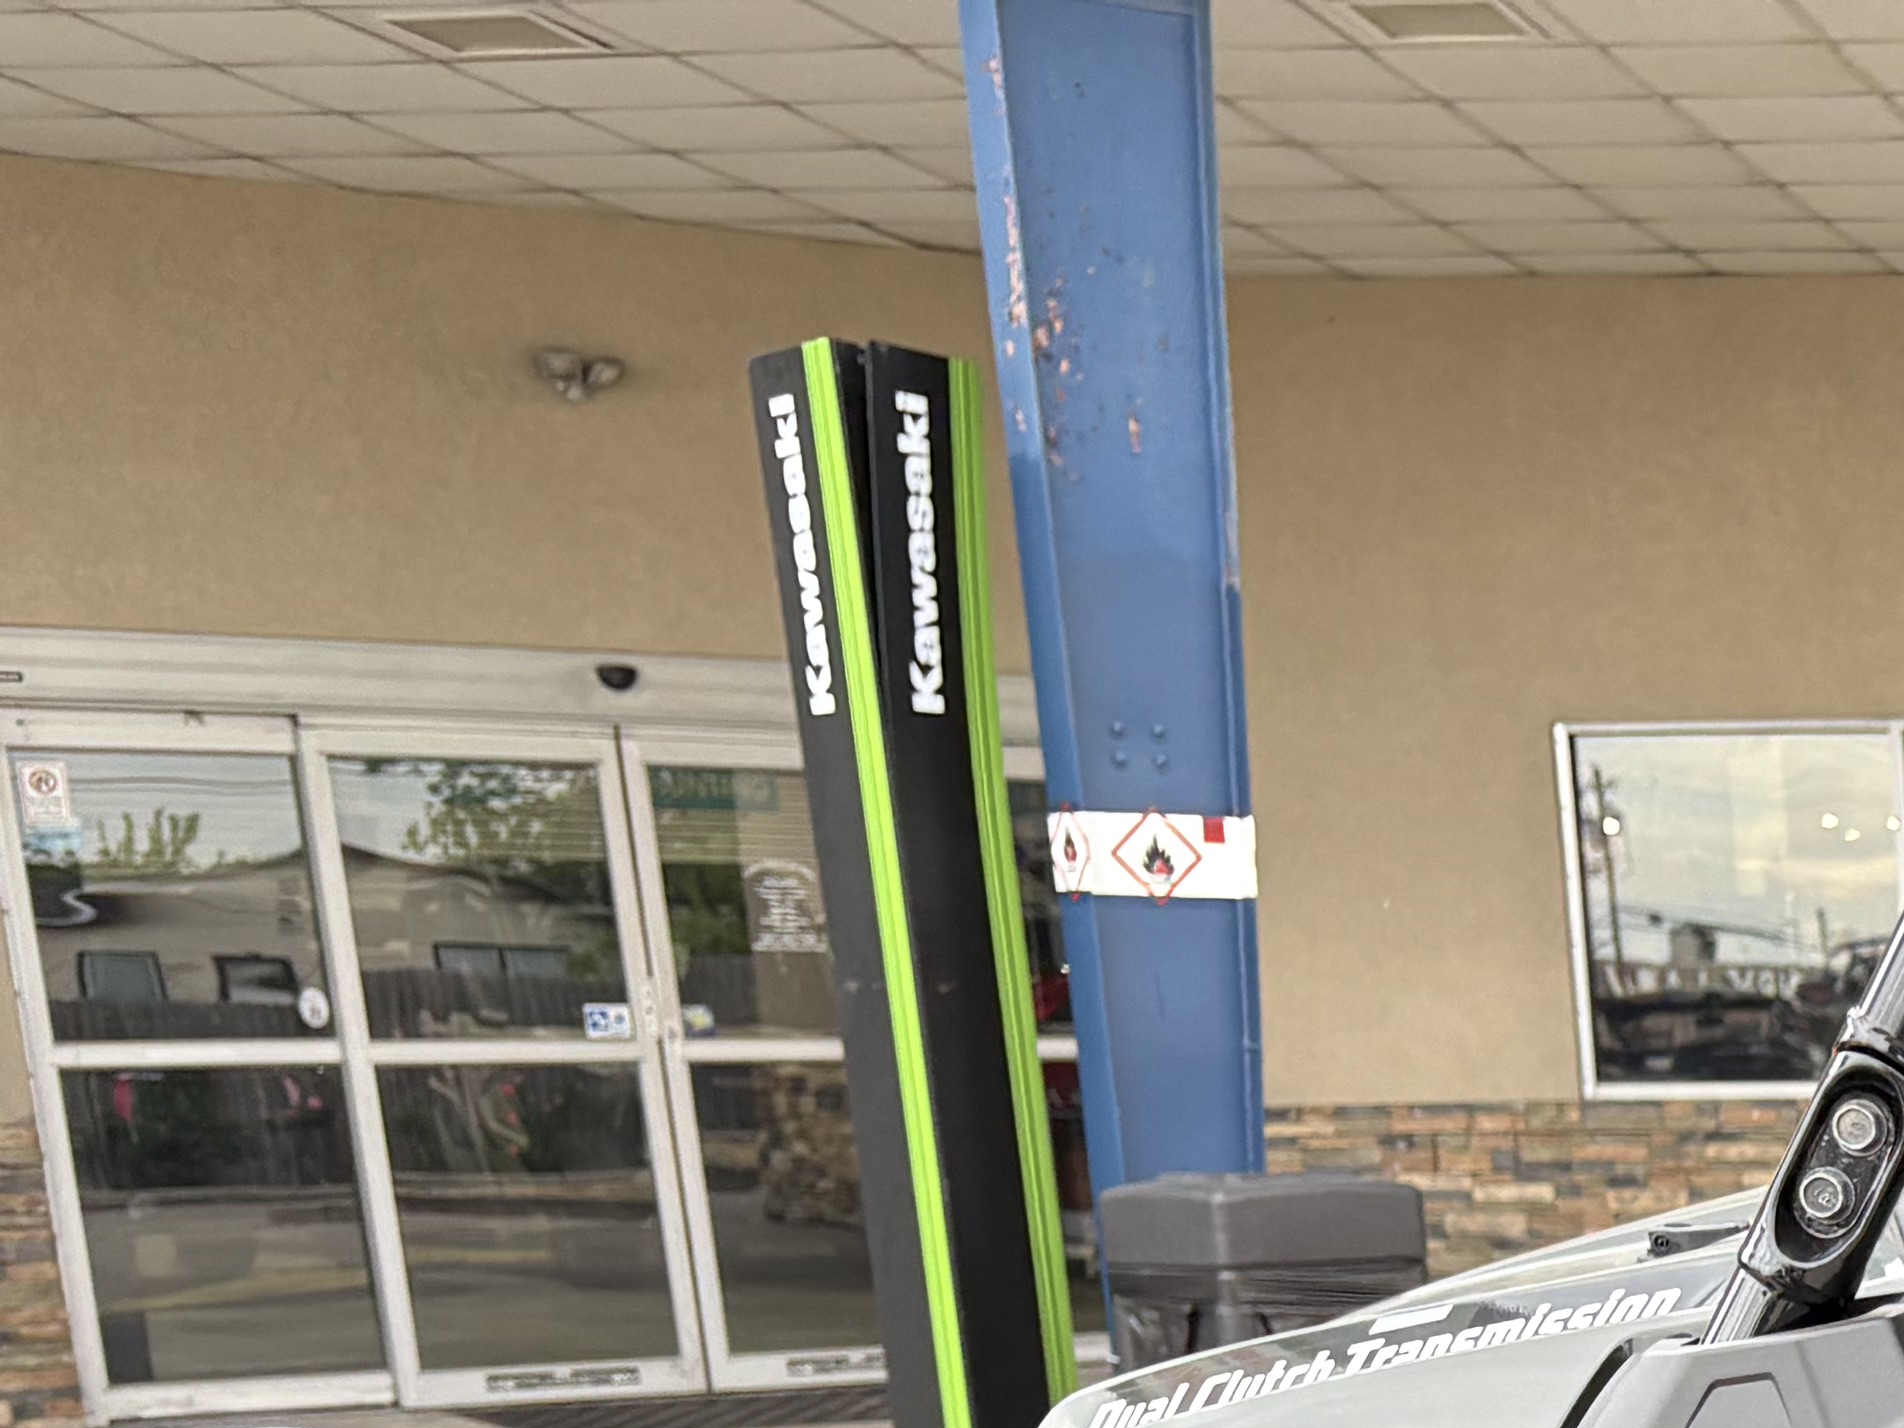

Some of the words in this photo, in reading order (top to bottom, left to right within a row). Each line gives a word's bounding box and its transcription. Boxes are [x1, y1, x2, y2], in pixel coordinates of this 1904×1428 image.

[768, 393, 836, 715] Kawasaki
[894, 389, 946, 715] Kawasaki
[1189, 1350, 1336, 1414] Clutch
